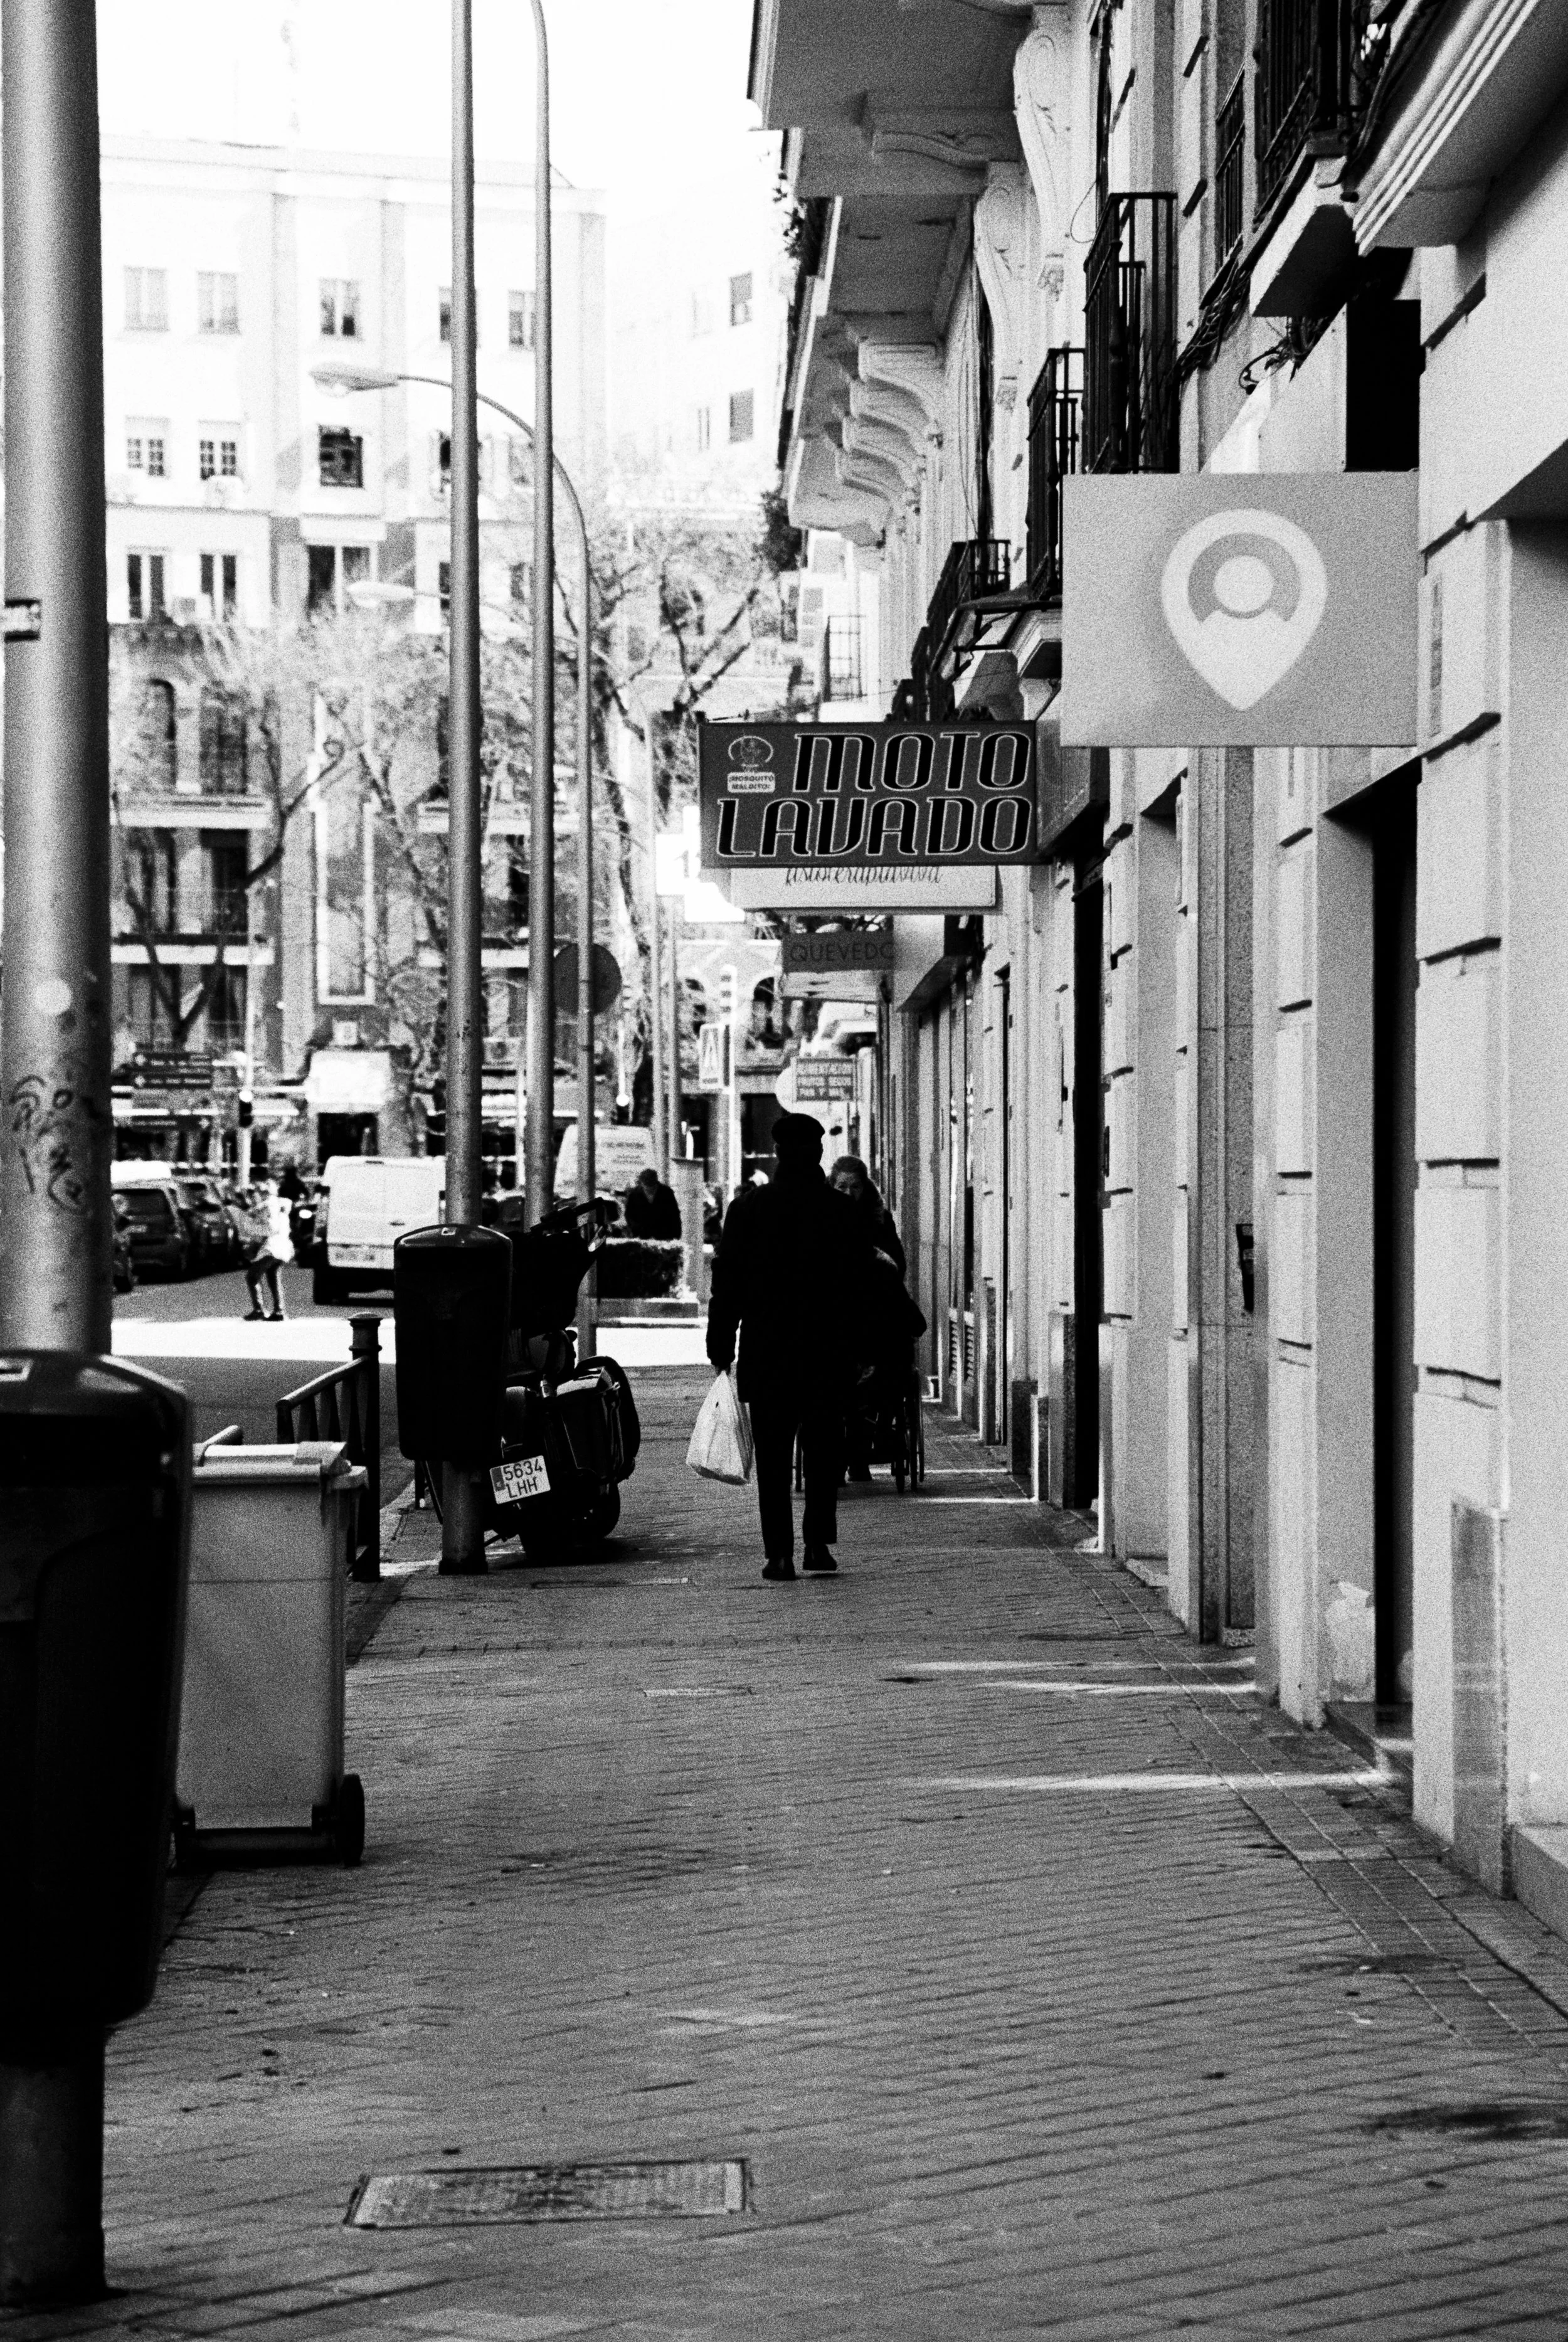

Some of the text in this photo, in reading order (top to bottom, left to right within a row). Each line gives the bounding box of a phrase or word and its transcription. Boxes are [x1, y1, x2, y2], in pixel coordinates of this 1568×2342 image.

[793, 733, 1030, 792] MOTO
[717, 797, 1032, 857] LAVADO
[503, 1459, 543, 1480] 5634
[506, 1477, 538, 1498] LHH
